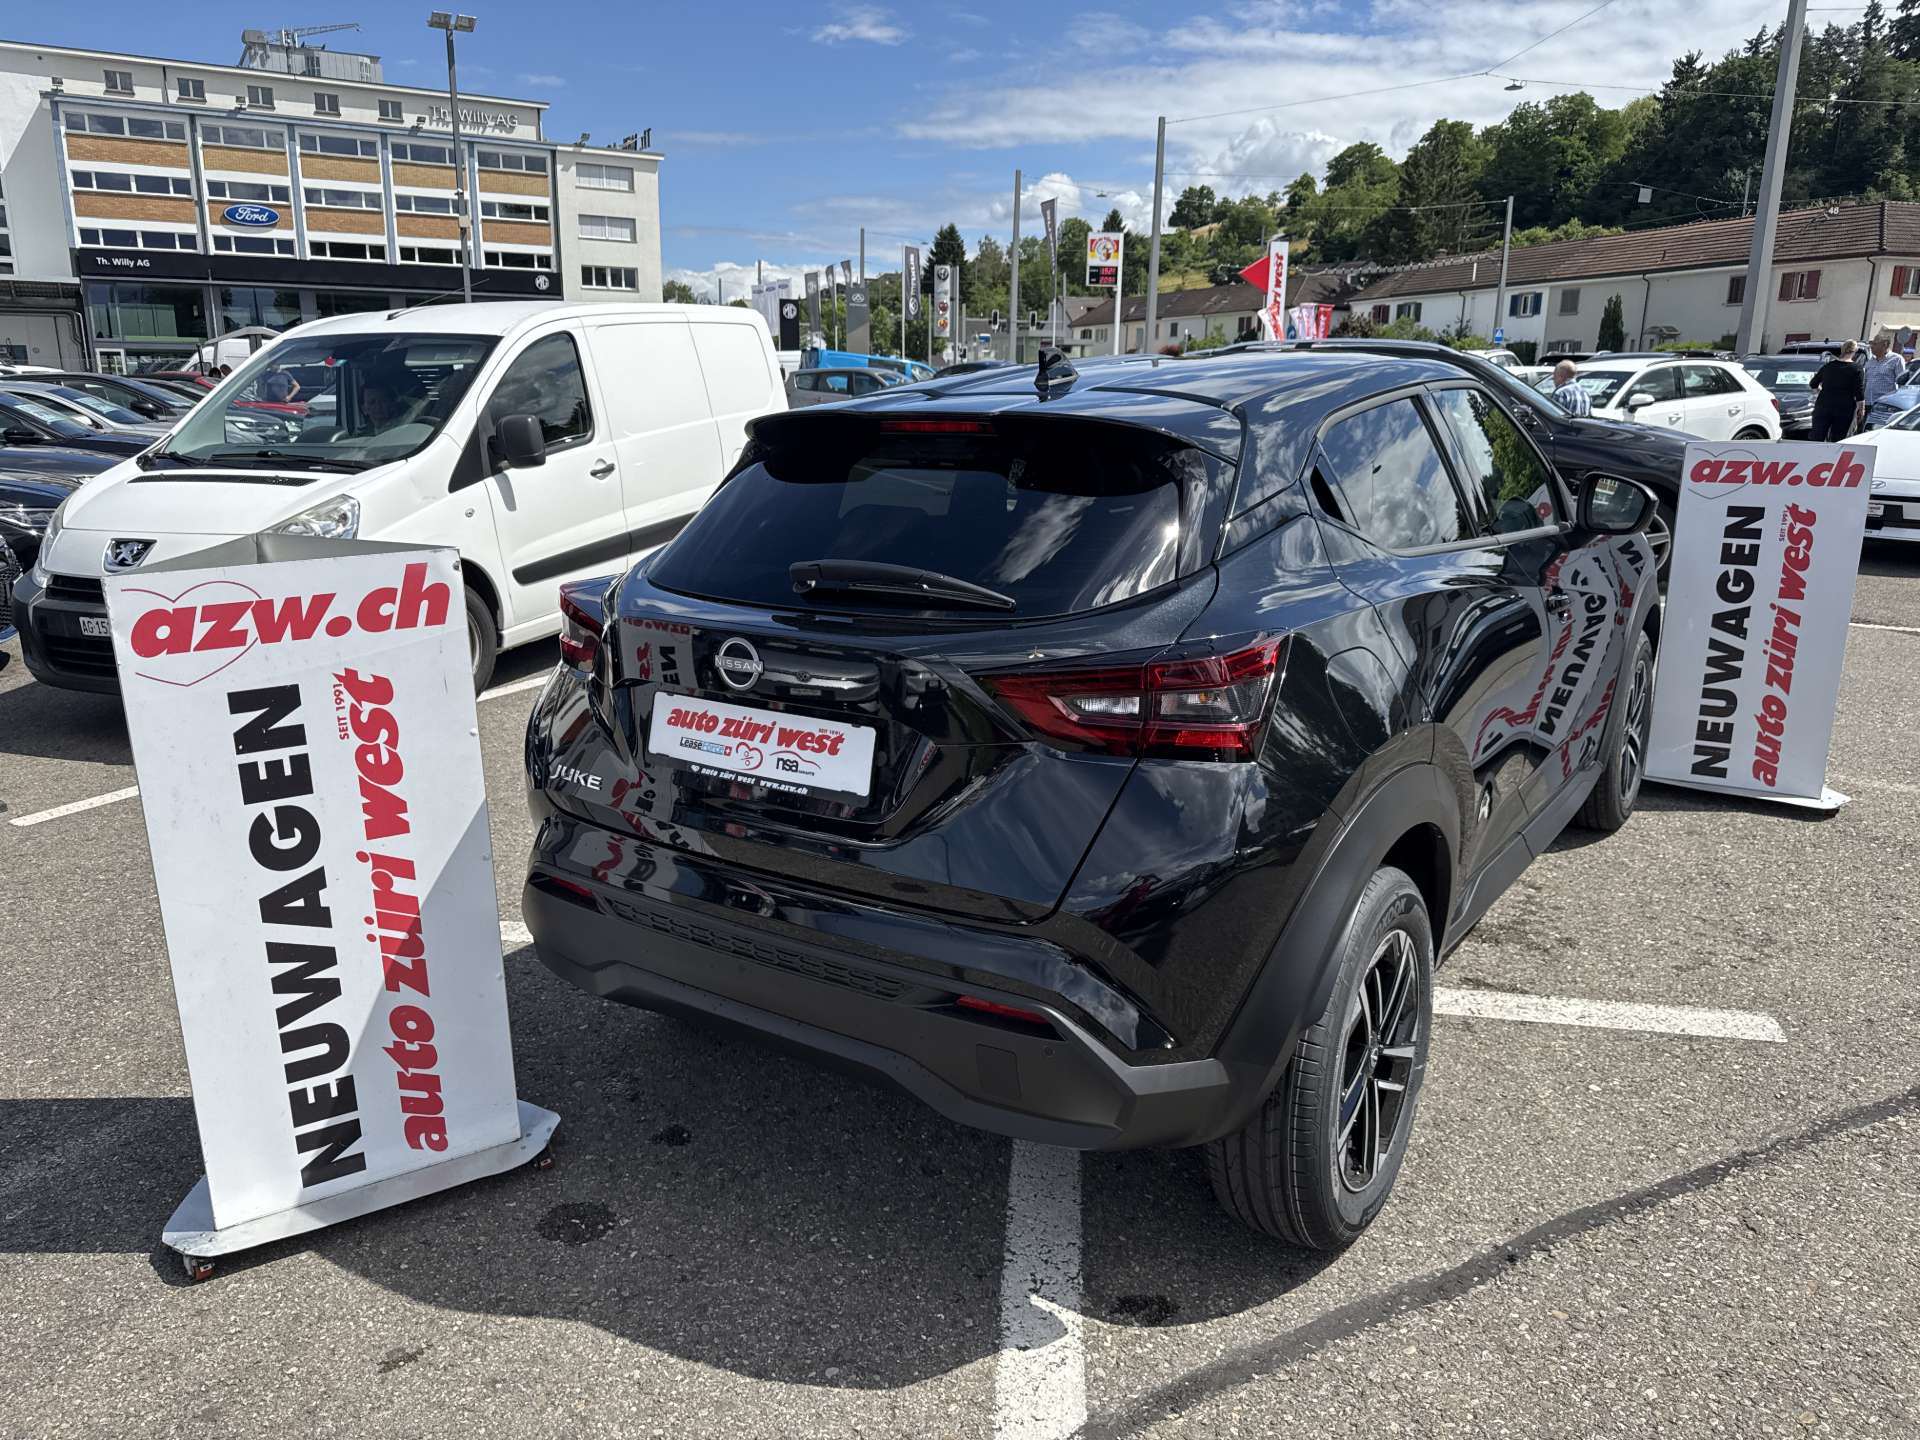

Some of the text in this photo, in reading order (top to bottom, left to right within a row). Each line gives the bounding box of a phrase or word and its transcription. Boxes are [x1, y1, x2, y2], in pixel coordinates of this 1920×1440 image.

[458, 109, 492, 126] Willy
[497, 112, 519, 127] AG
[235, 206, 269, 222] Ford
[96, 257, 150, 268] Th. Willy AG
[782, 303, 798, 319] MG
[1690, 451, 1866, 488] azw.ch
[1779, 528, 1787, 542] SEIT
[131, 562, 451, 658] azw.ch
[82, 620, 94, 634] AG
[1691, 505, 1766, 779] NEUWAGEN
[1752, 502, 1817, 787] auto züri west
[715, 655, 764, 673] NISSAN
[333, 683, 350, 741] SEIT 1991
[667, 707, 845, 757] auto züri west
[701, 767, 718, 778] auto
[719, 770, 736, 782] züri
[737, 774, 756, 785] west
[776, 757, 799, 773] nsa
[549, 764, 603, 791] JUKE
[332, 667, 449, 1152] auto züri west
[227, 683, 367, 1188] NEUWAGEN
